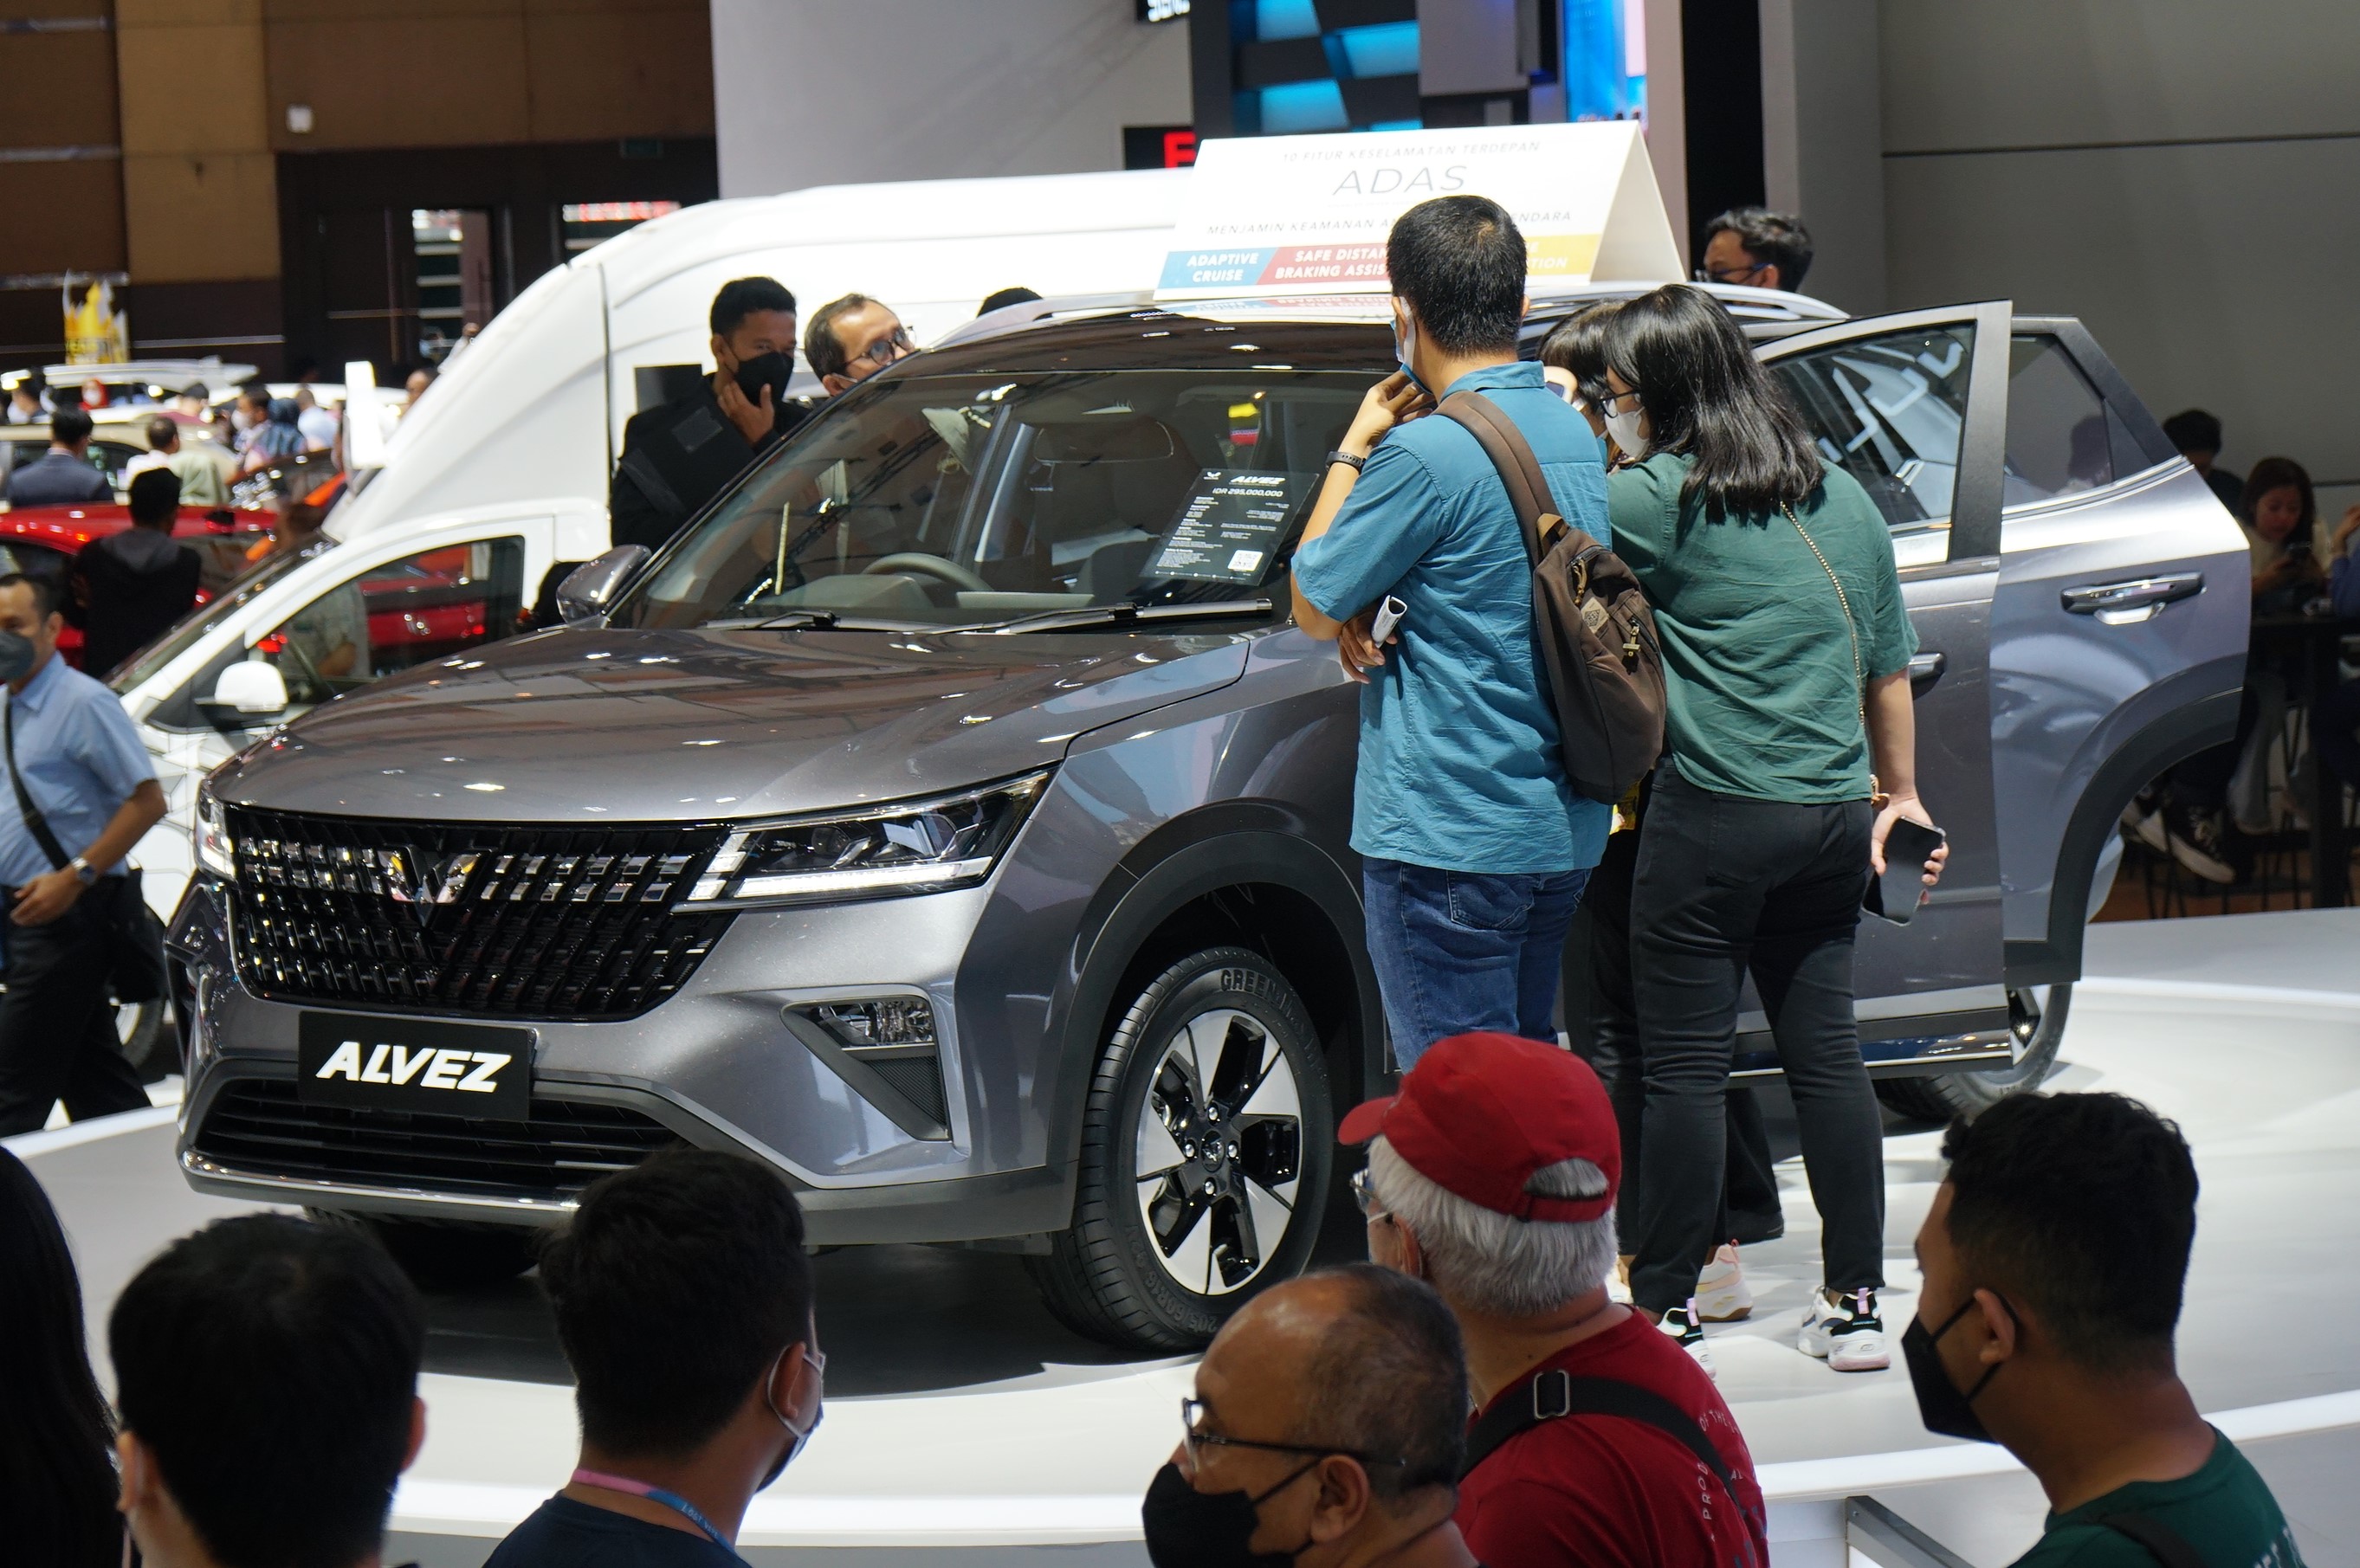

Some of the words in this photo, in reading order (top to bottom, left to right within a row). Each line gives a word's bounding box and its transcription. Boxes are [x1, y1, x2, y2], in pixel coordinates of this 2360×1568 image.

[1303, 151, 1343, 161] FITUR
[1348, 143, 1458, 159] KESELAMATAN
[1461, 140, 1541, 155] TERDEPAN
[1332, 165, 1469, 196] ADAS
[1207, 222, 1285, 235] MENJAMIN
[1289, 218, 1375, 232] KEAMANAN
[1186, 252, 1259, 267] ADAPTIVE
[1295, 248, 1333, 262] SAFE
[1192, 268, 1244, 283] CRUISE
[1274, 264, 1342, 280] BRAKING
[1230, 475, 1286, 485] ALVEZ
[315, 1041, 512, 1094] ALVEZ
